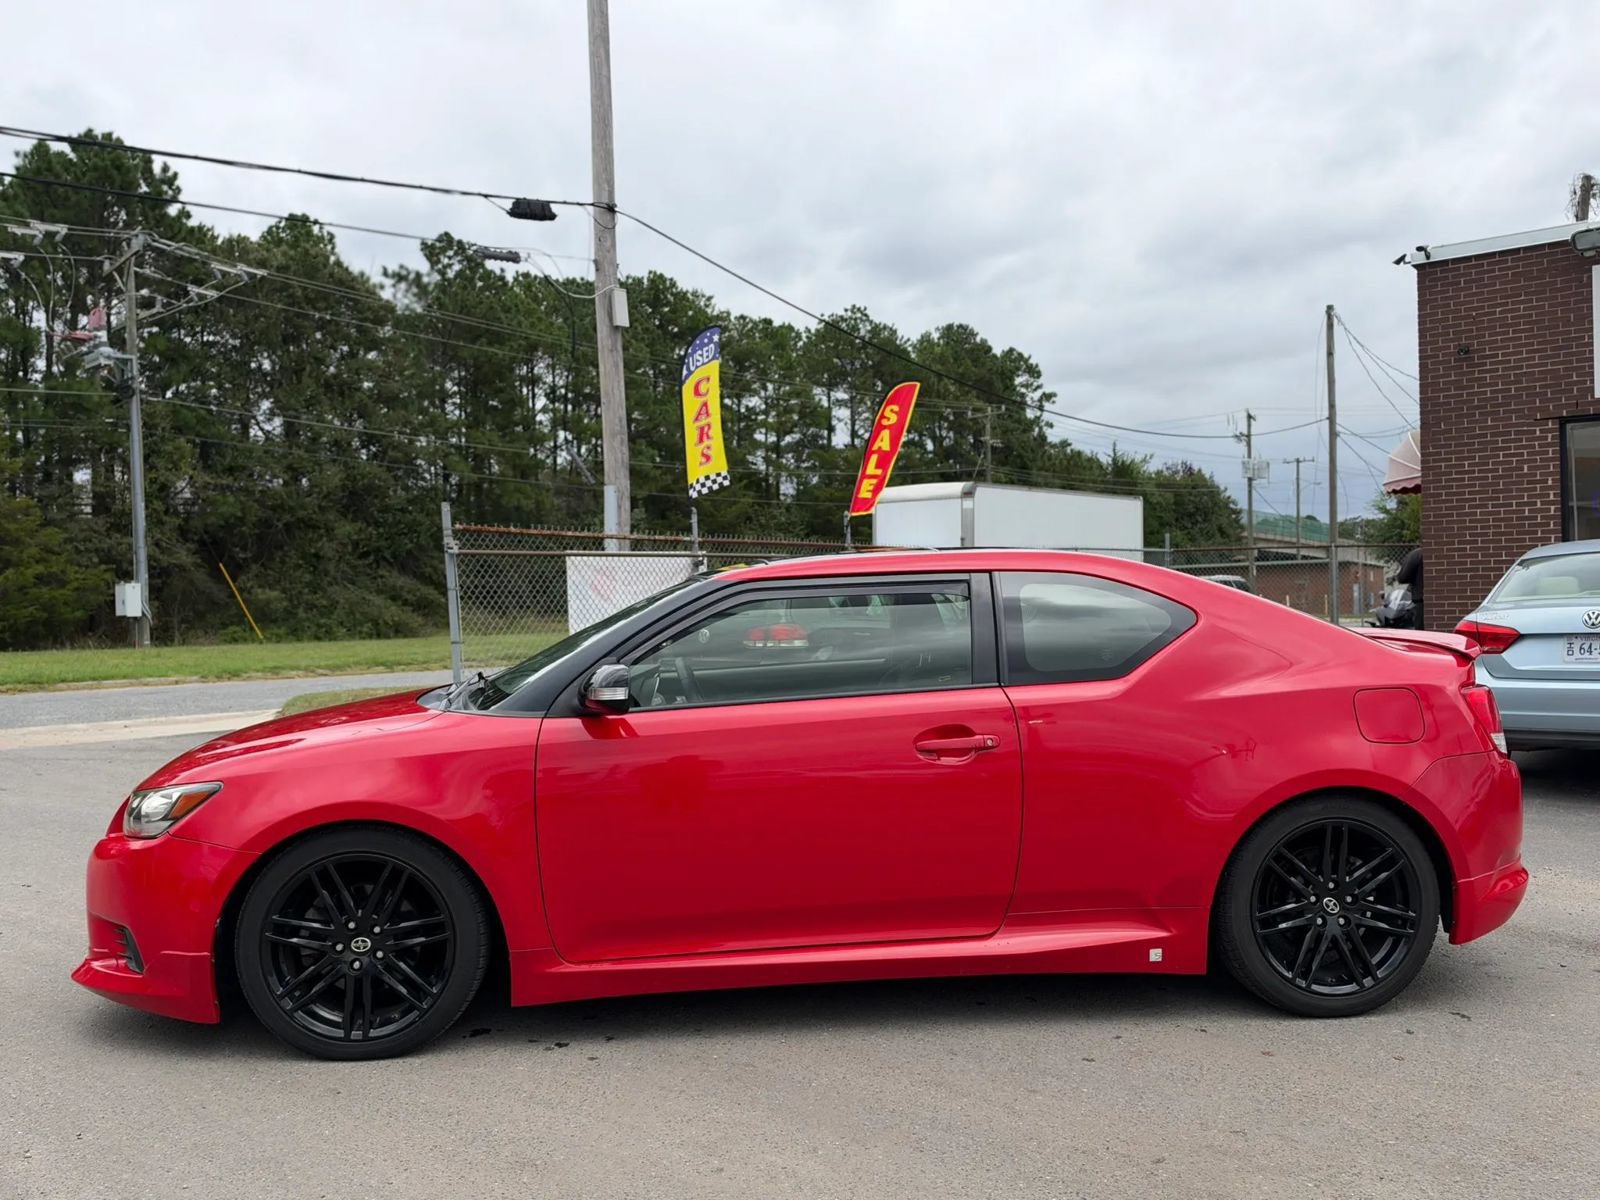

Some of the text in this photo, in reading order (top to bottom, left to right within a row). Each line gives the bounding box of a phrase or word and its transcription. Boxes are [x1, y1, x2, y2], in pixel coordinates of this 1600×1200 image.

[689, 344, 715, 371] USED
[693, 375, 713, 467] CARS
[857, 404, 900, 499] SALE
